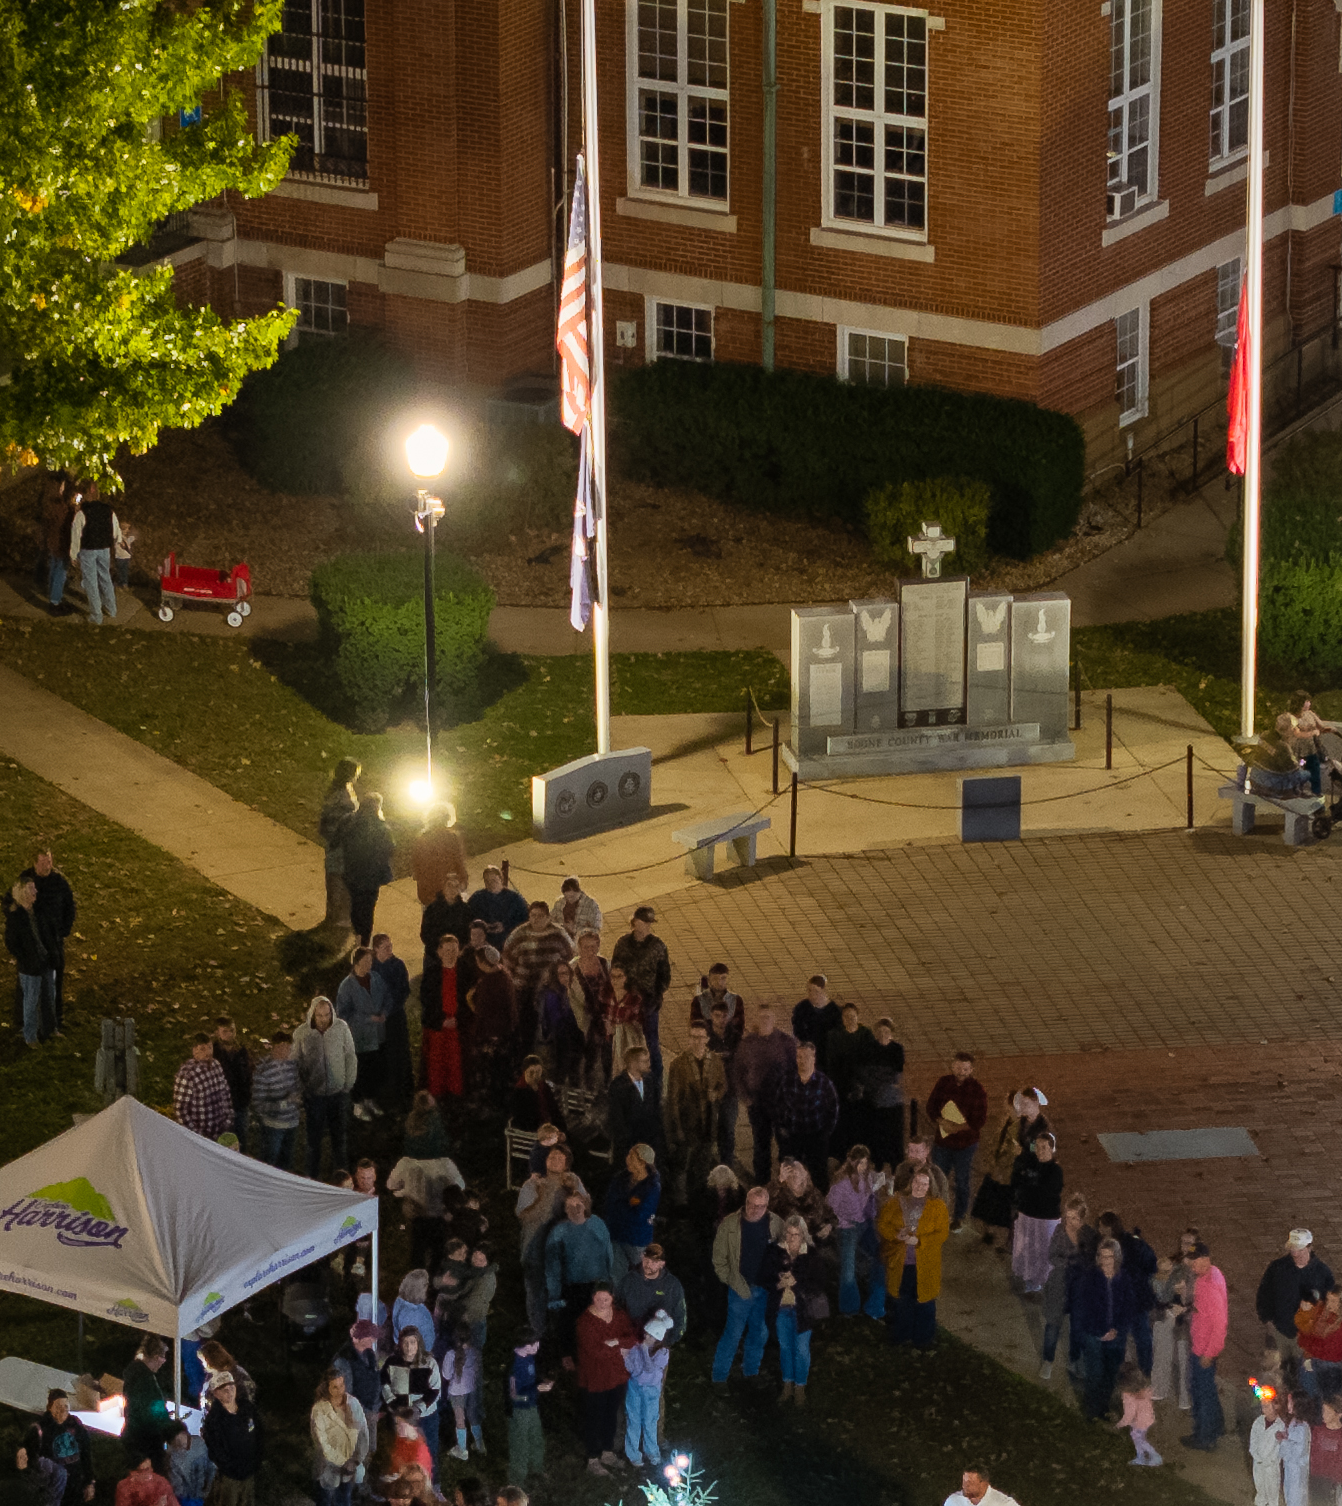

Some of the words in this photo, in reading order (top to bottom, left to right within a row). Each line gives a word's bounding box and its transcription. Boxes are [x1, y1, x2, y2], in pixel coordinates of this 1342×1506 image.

[847, 737, 887, 750] BOONE
[888, 735, 930, 748] COUNTY
[937, 731, 959, 743] WAR
[964, 728, 1022, 743] MEMORIAL
